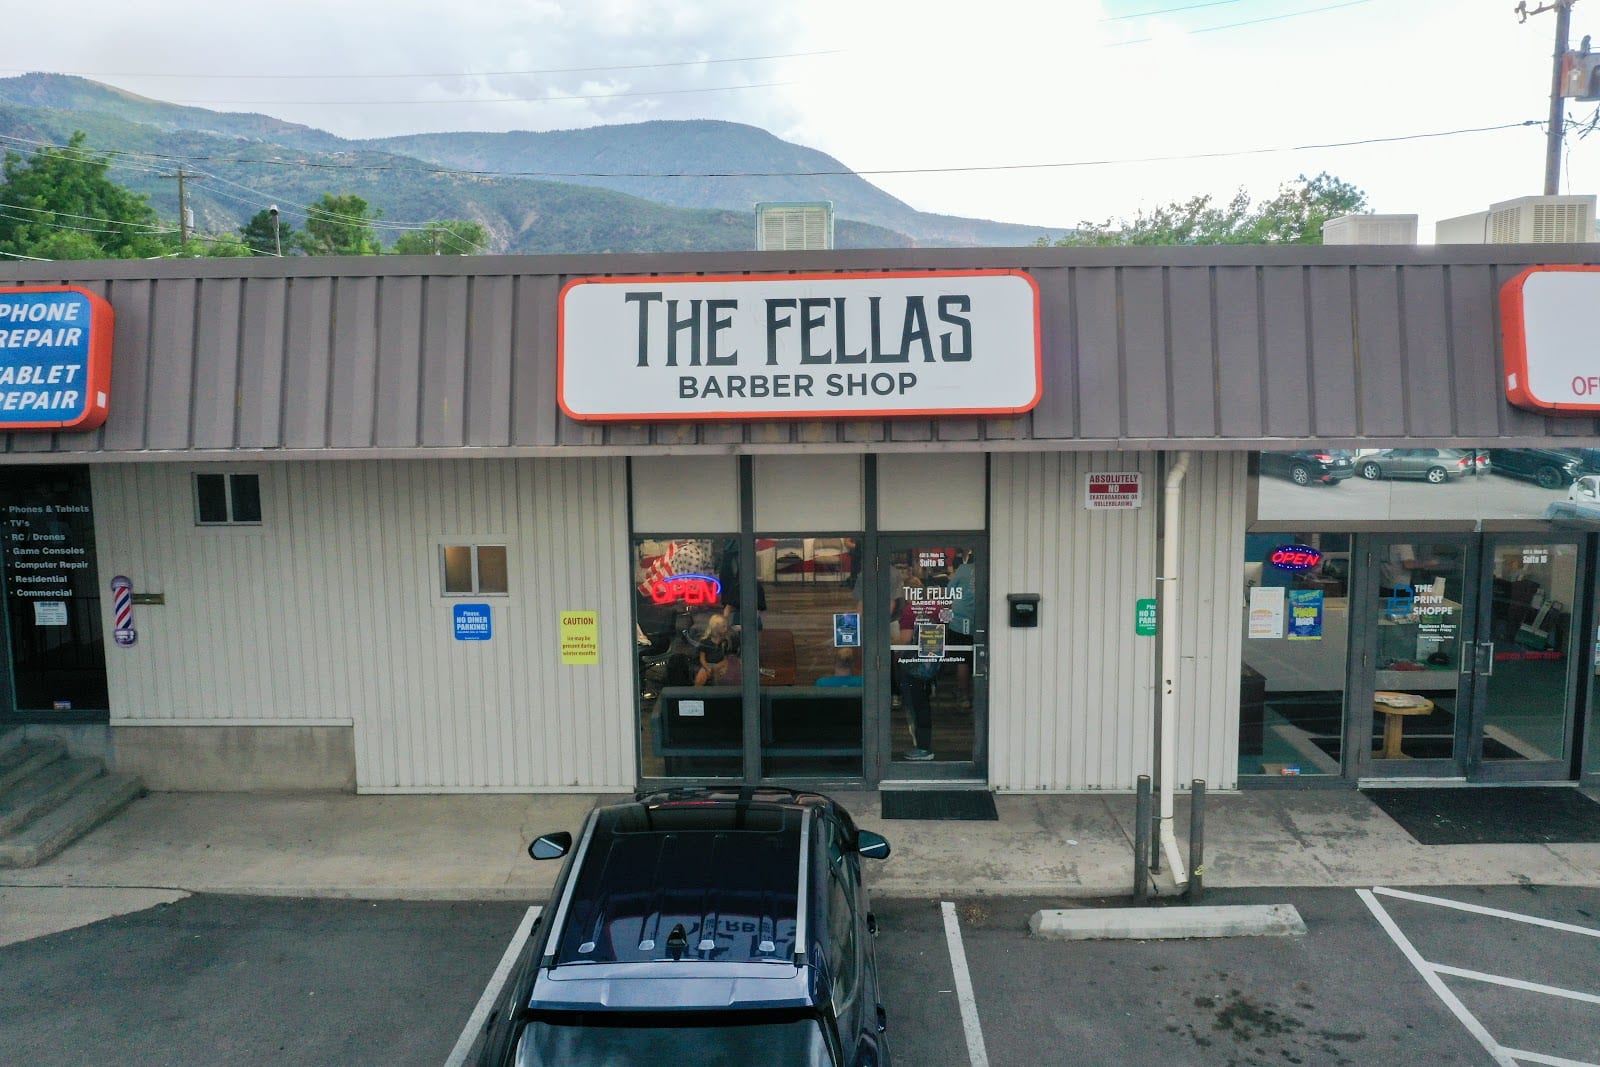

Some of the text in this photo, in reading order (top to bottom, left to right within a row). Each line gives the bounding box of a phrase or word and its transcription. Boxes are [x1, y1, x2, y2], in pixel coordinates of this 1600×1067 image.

[0, 302, 81, 322] PHONE
[625, 291, 972, 367] THE FELLAS
[0, 364, 81, 385] ABLET
[678, 372, 918, 399] BARBER SHOP
[1571, 375, 1600, 396] OF
[1090, 474, 1138, 484] ABSOLUTELY
[1109, 484, 1120, 493] NO
[8, 505, 90, 513] Phones & Tablets
[9, 519, 31, 527] TV's
[11, 533, 25, 541] RC
[32, 533, 66, 541] Drones
[12, 547, 85, 555] Game Consoles
[919, 559, 937, 567] Suite
[1272, 552, 1320, 567] OPEN
[1522, 555, 1540, 564] Suite
[14, 561, 89, 570] Computer Repair
[15, 575, 68, 583] Residential
[16, 589, 73, 597] Commercial
[652, 579, 718, 605] OPEN
[903, 586, 963, 600] THE FELLAS
[1414, 584, 1433, 593] THE
[1413, 595, 1443, 604] PRINT
[1412, 606, 1453, 616] SHOPPE
[456, 616, 488, 624] NO DINER
[563, 617, 594, 626] CAUTION
[456, 623, 488, 631] PARKING!
